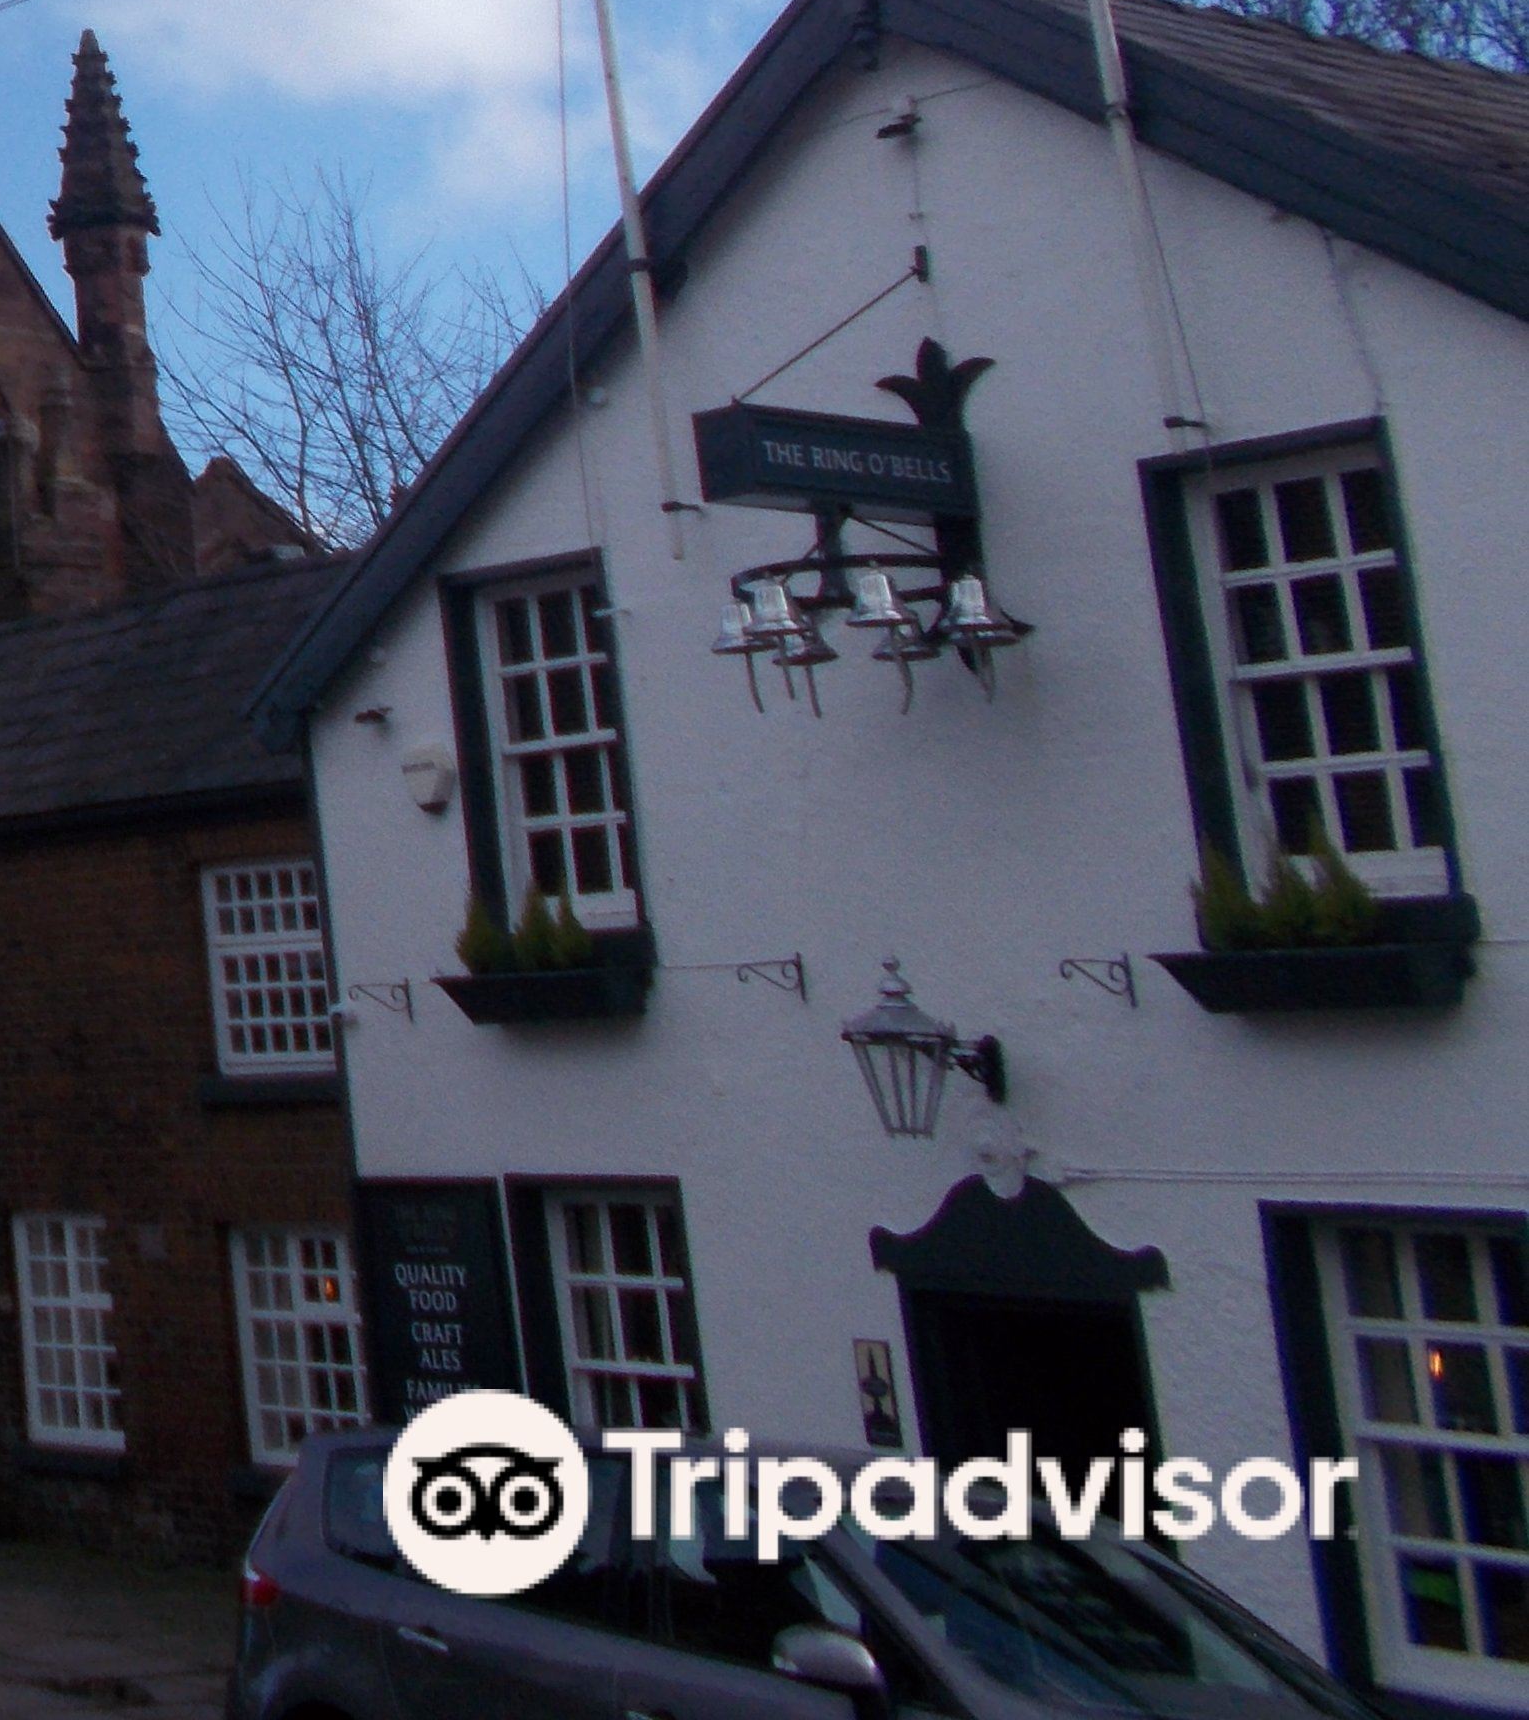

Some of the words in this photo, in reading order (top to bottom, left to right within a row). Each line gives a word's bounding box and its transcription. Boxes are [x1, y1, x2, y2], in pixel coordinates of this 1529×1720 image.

[762, 440, 806, 467] THE
[810, 445, 864, 474] RING
[867, 452, 953, 483] O'BELLS
[394, 1263, 467, 1287] QUALITY
[409, 1290, 457, 1312] FOOD
[411, 1321, 463, 1345] CRAFT
[419, 1348, 462, 1371] ALES
